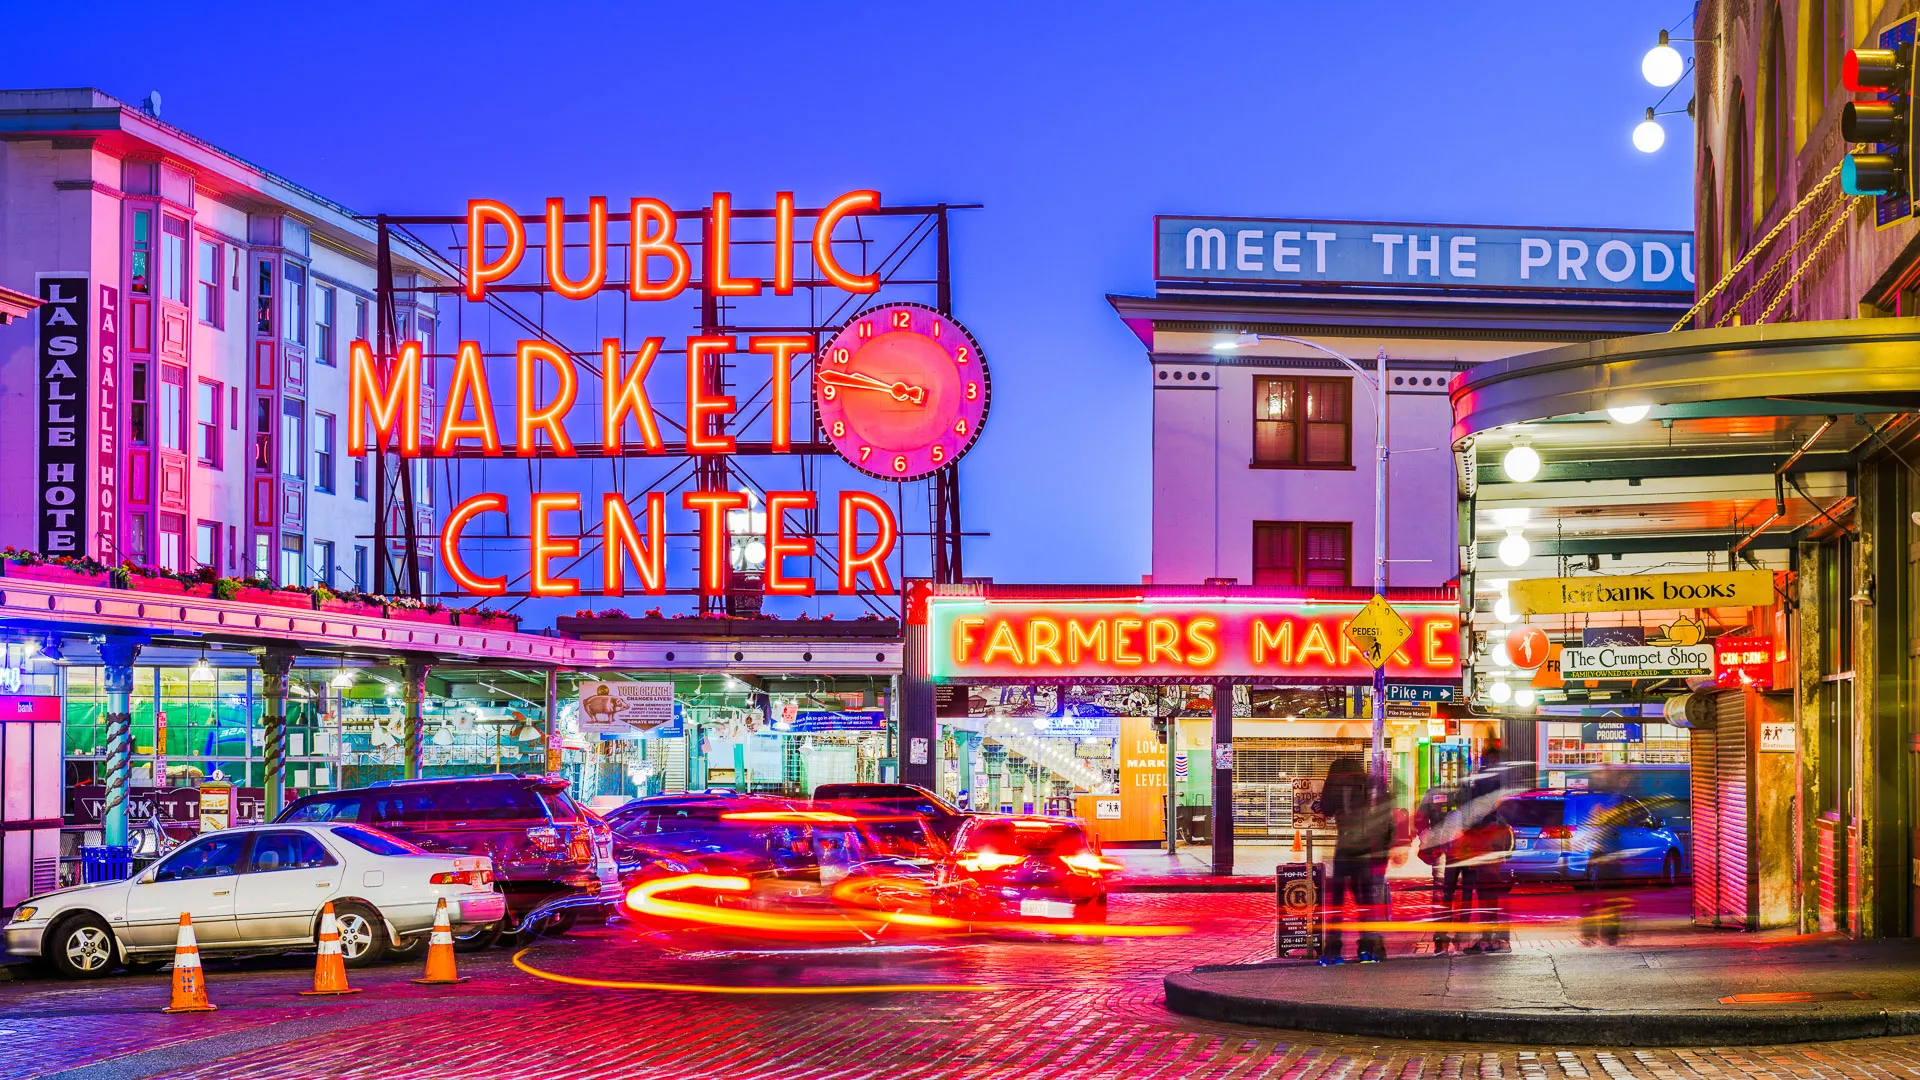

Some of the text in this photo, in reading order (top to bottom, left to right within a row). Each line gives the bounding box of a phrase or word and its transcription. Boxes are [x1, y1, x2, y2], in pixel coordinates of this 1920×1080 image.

[467, 190, 881, 302] PUBLIC
[1186, 228, 1336, 273] MEET
[1372, 234, 1476, 278] THE
[102, 289, 115, 333] LA
[894, 312, 910, 328] 12
[859, 322, 872, 337] 11
[935, 321, 939, 337] 1
[833, 348, 849, 364] 10
[957, 347, 968, 363] 2
[101, 345, 114, 453] SALLE
[348, 336, 817, 457] MARKET
[823, 385, 836, 400] 9
[967, 383, 977, 399] 3
[45, 284, 78, 559] LA SALLE HOTE
[833, 421, 845, 436] 8
[955, 420, 967, 434] 4
[860, 447, 871, 461] 7
[932, 446, 943, 461] 5
[894, 456, 906, 472] 6
[441, 491, 898, 596] CENTER
[1663, 580, 1736, 600] books
[957, 619, 1454, 664] FARMERS MAE
[1567, 647, 1708, 669] The Crumpet Shop
[1720, 652, 1760, 665] CAN CAN
[618, 686, 638, 696] YOUR
[1391, 686, 1416, 699] Pike
[18, 702, 33, 712] bank
[1597, 730, 1627, 741] PRODUCE
[1136, 774, 1168, 787] LEVEL
[93, 801, 178, 818] MRKET
